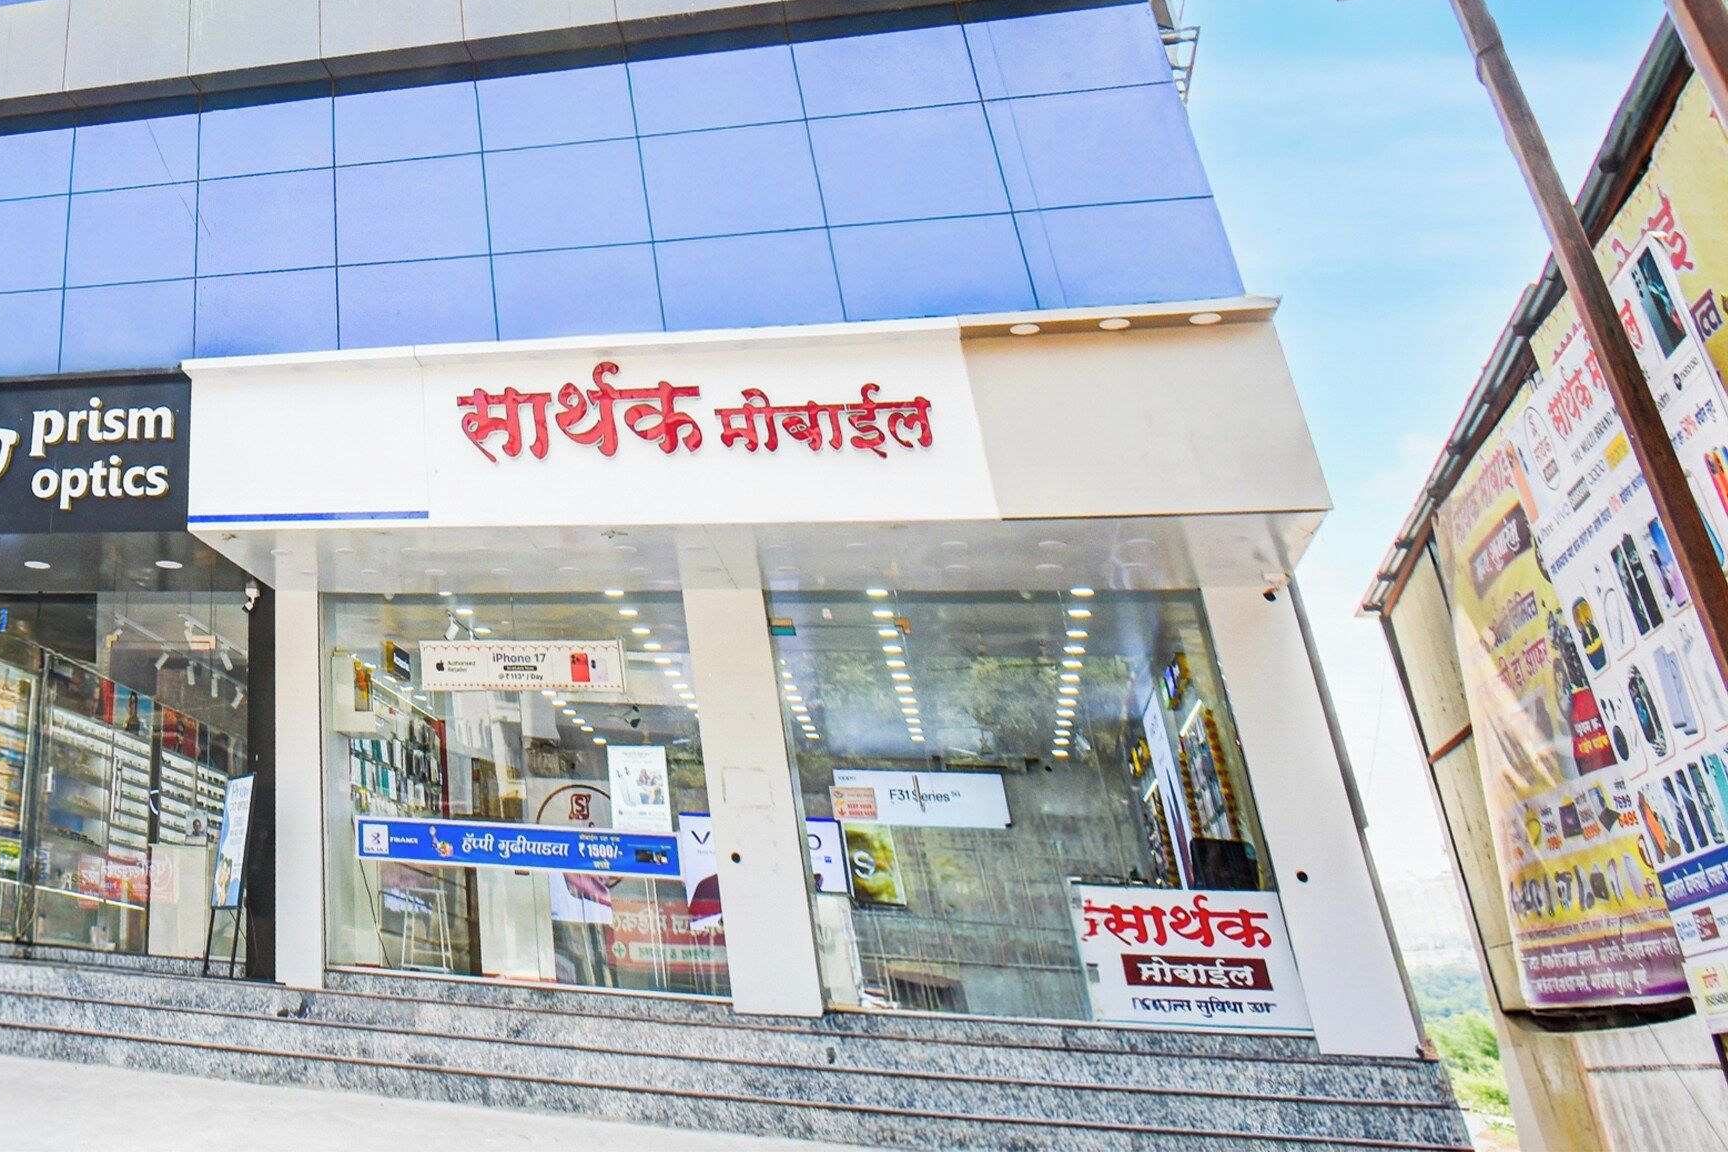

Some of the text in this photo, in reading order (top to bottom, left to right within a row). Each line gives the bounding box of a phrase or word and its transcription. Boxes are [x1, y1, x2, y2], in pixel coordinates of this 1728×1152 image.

[30, 396, 174, 459] prism
[456, 361, 933, 463] सार्थक मोबाईल
[31, 454, 169, 510] optics
[492, 652, 546, 664] iPhone 17
[889, 788, 910, 801] F31
[461, 832, 495, 853] हॅप्पी
[498, 833, 570, 859] गुढीपाडवा
[1103, 894, 1272, 949] सार्थक
[1136, 956, 1254, 989] मोबाईल
[1195, 996, 1244, 1018] सुविधा
